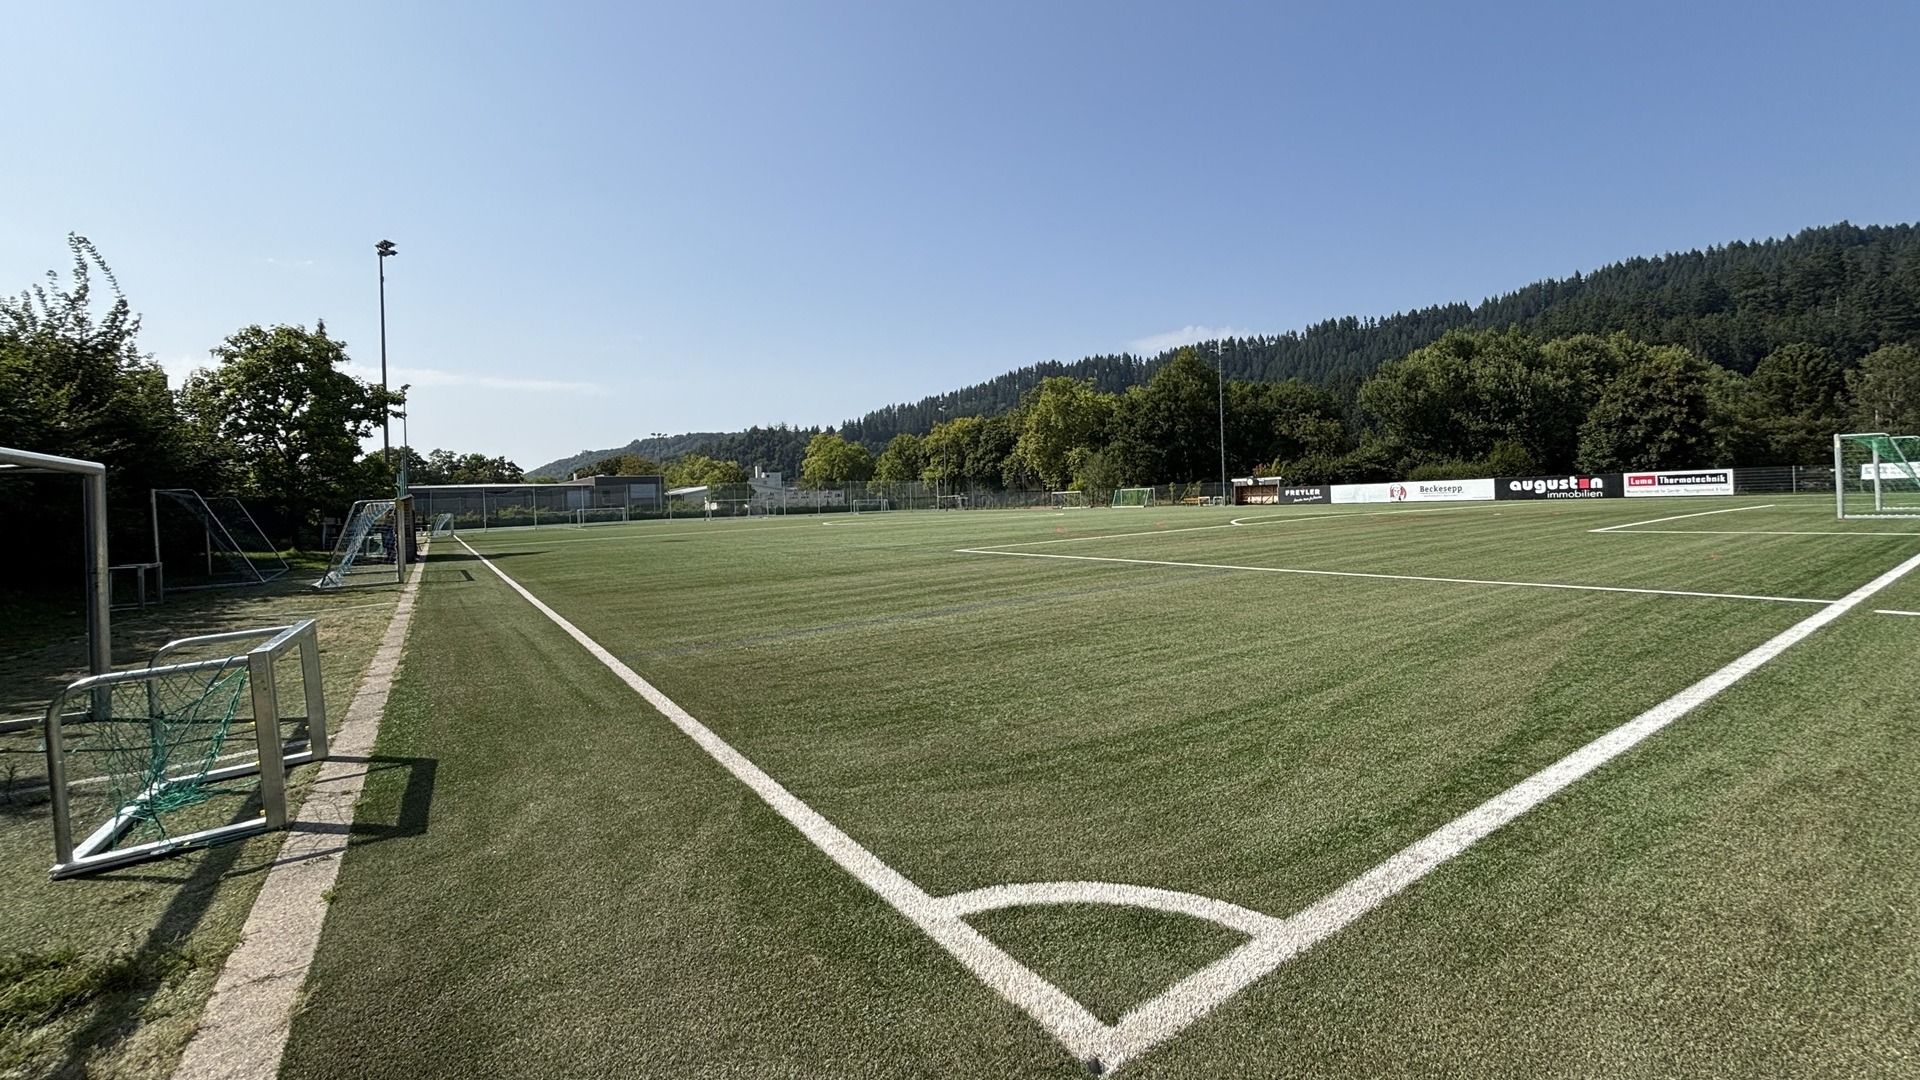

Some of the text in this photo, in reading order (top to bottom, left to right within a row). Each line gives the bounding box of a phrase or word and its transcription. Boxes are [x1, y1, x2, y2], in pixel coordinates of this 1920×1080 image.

[1658, 474, 1726, 484] Thermotechnik
[1420, 485, 1463, 494] Beckesepp
[1547, 490, 1603, 499] immobilien
